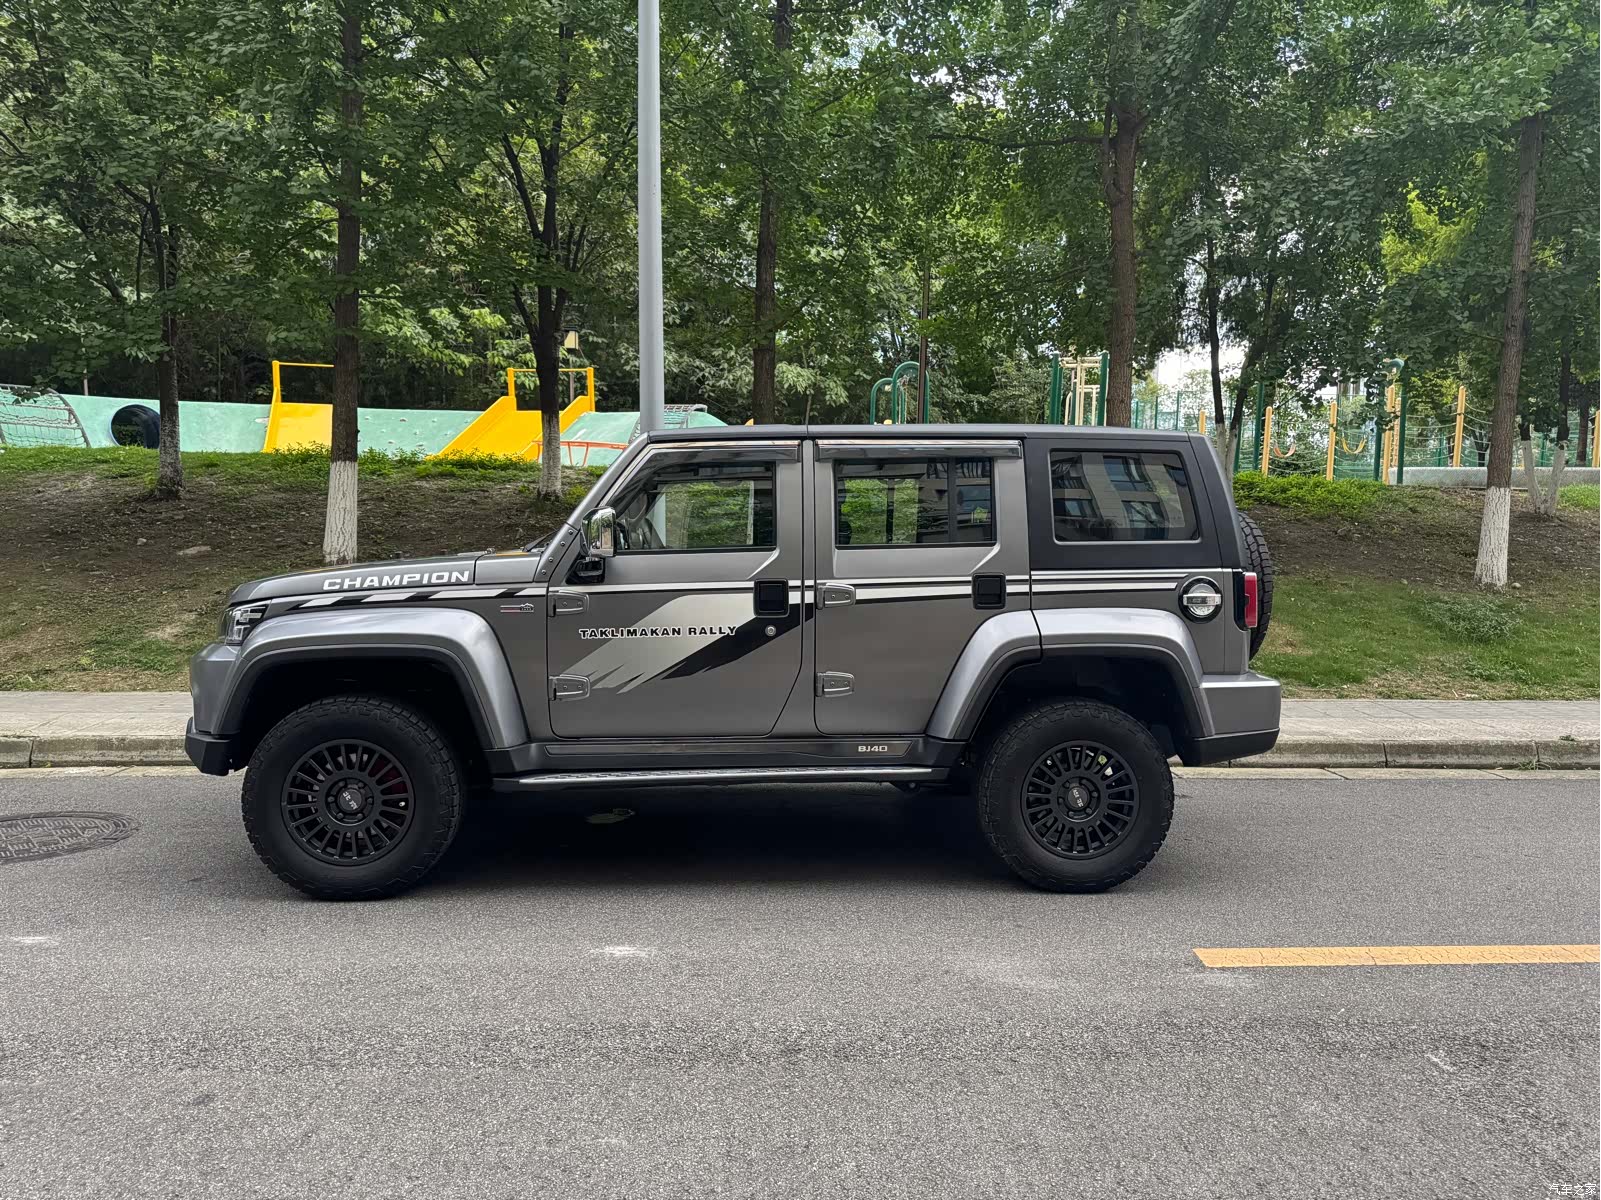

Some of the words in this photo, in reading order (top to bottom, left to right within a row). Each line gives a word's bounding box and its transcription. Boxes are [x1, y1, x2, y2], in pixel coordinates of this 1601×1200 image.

[323, 571, 470, 590] CHAMPION
[579, 626, 682, 640] TAKLIMAKAN
[688, 625, 737, 637] RALLY
